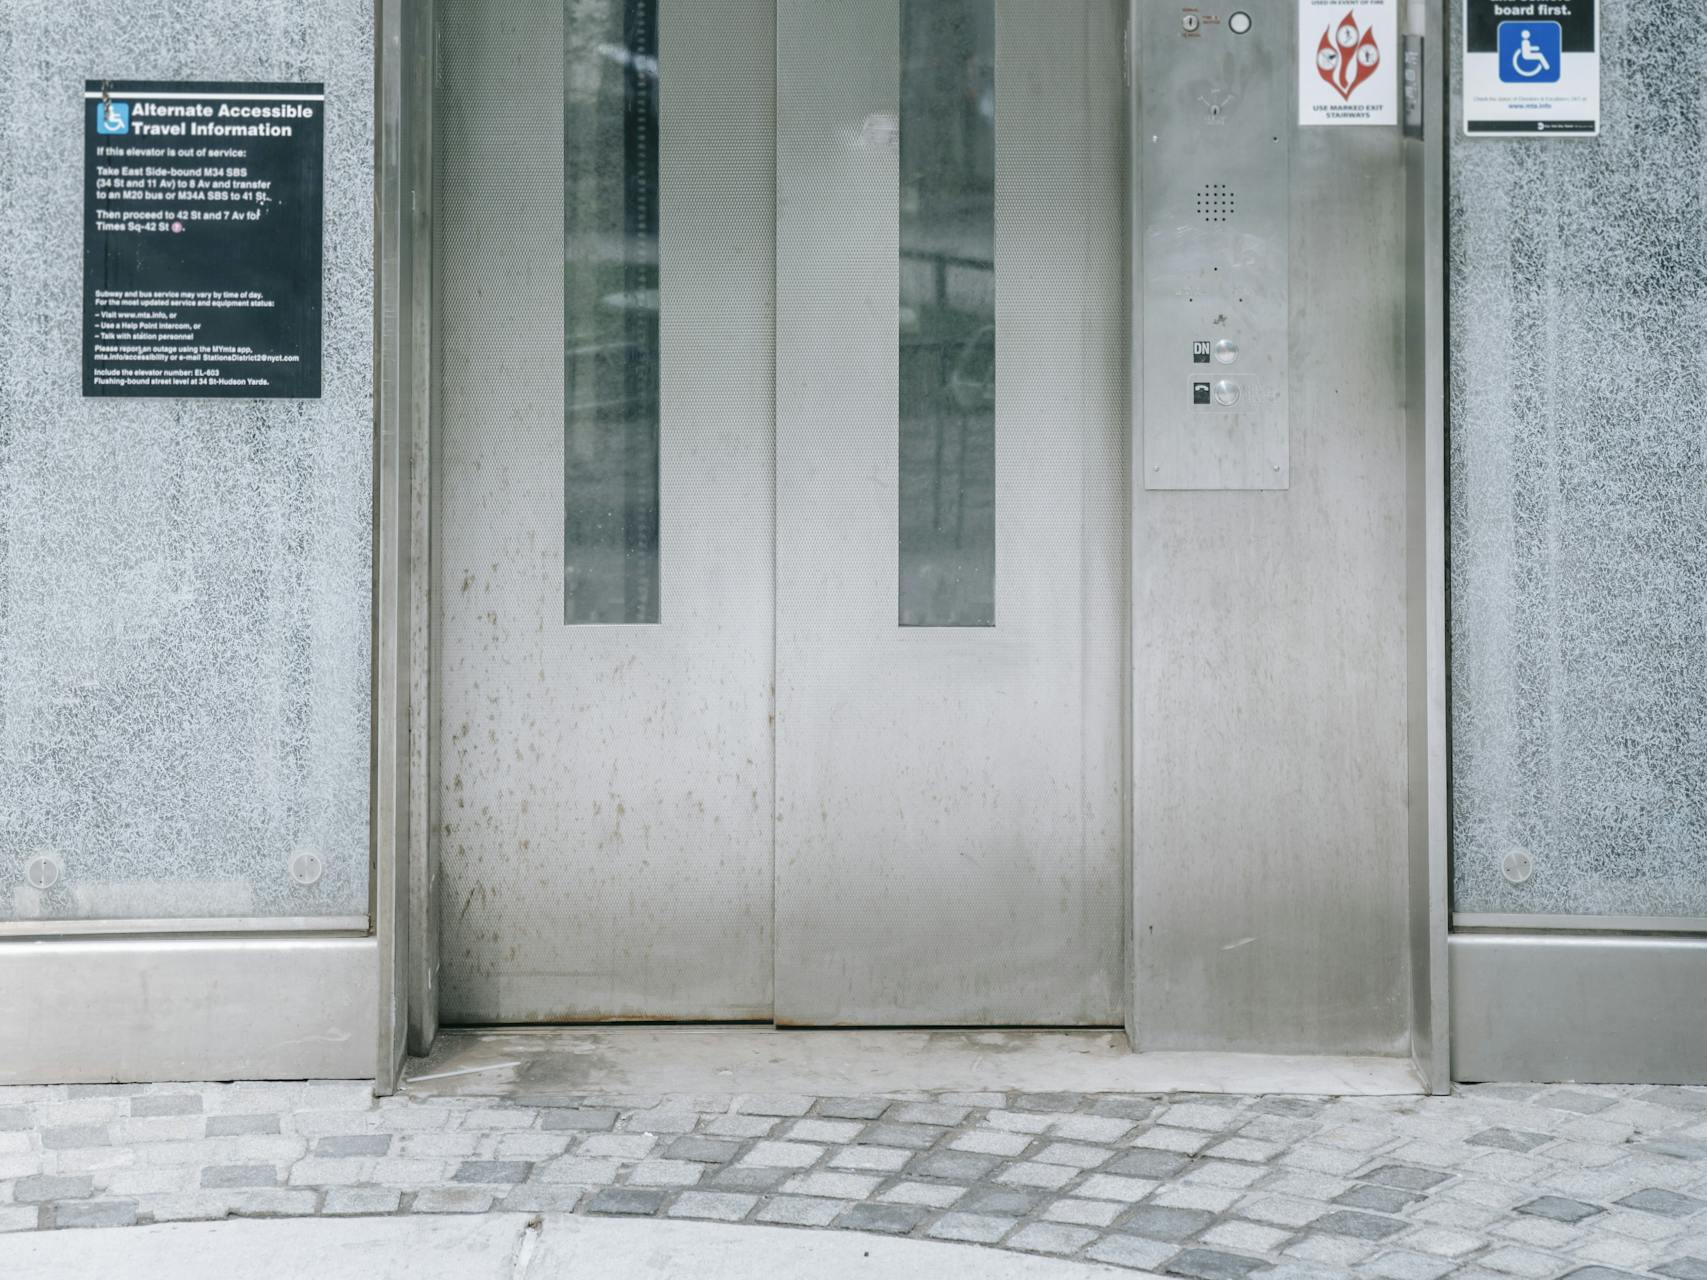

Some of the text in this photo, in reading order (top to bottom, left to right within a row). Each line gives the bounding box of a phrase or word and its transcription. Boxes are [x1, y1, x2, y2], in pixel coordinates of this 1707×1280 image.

[1494, 5, 1571, 15] board first.
[132, 103, 313, 118] Alternate Accessible
[132, 122, 292, 137] Travel Information
[97, 147, 104, 156] If
[106, 148, 124, 156] this
[126, 148, 165, 156] elevator
[178, 149, 194, 157] out
[196, 148, 206, 157] of
[208, 149, 246, 157] service:
[97, 167, 247, 177] Take East Side-bound M34 SBS
[97, 179, 111, 188] (34
[114, 180, 124, 188] St
[126, 180, 144, 188] and
[147, 180, 156, 188] 11
[160, 180, 175, 189] Av)
[178, 180, 187, 188] to
[212, 180, 230, 188] and
[232, 180, 270, 189] transfer
[97, 191, 106, 199] to
[123, 191, 142, 199] M20
[145, 192, 162, 200] bus
[178, 192, 205, 200] M34A
[208, 192, 228, 200] SBS
[230, 192, 240, 200] to
[96, 210, 120, 219] Then
[123, 211, 163, 221] proceed
[165, 211, 175, 219] to
[177, 211, 188, 219] 42
[191, 211, 201, 219] St
[203, 211, 221, 219] and
[232, 212, 245, 220] Av
[96, 222, 125, 231] Times
[128, 222, 156, 233] Sq-42
[159, 223, 169, 231] St
[95, 290, 122, 298] Subway
[213, 291, 222, 299] by
[249, 291, 263, 299] day.
[141, 299, 169, 307] updated
[158, 333, 193, 341] personnel
[1194, 343, 1209, 354] DN
[94, 377, 149, 385] Flushing-bound
